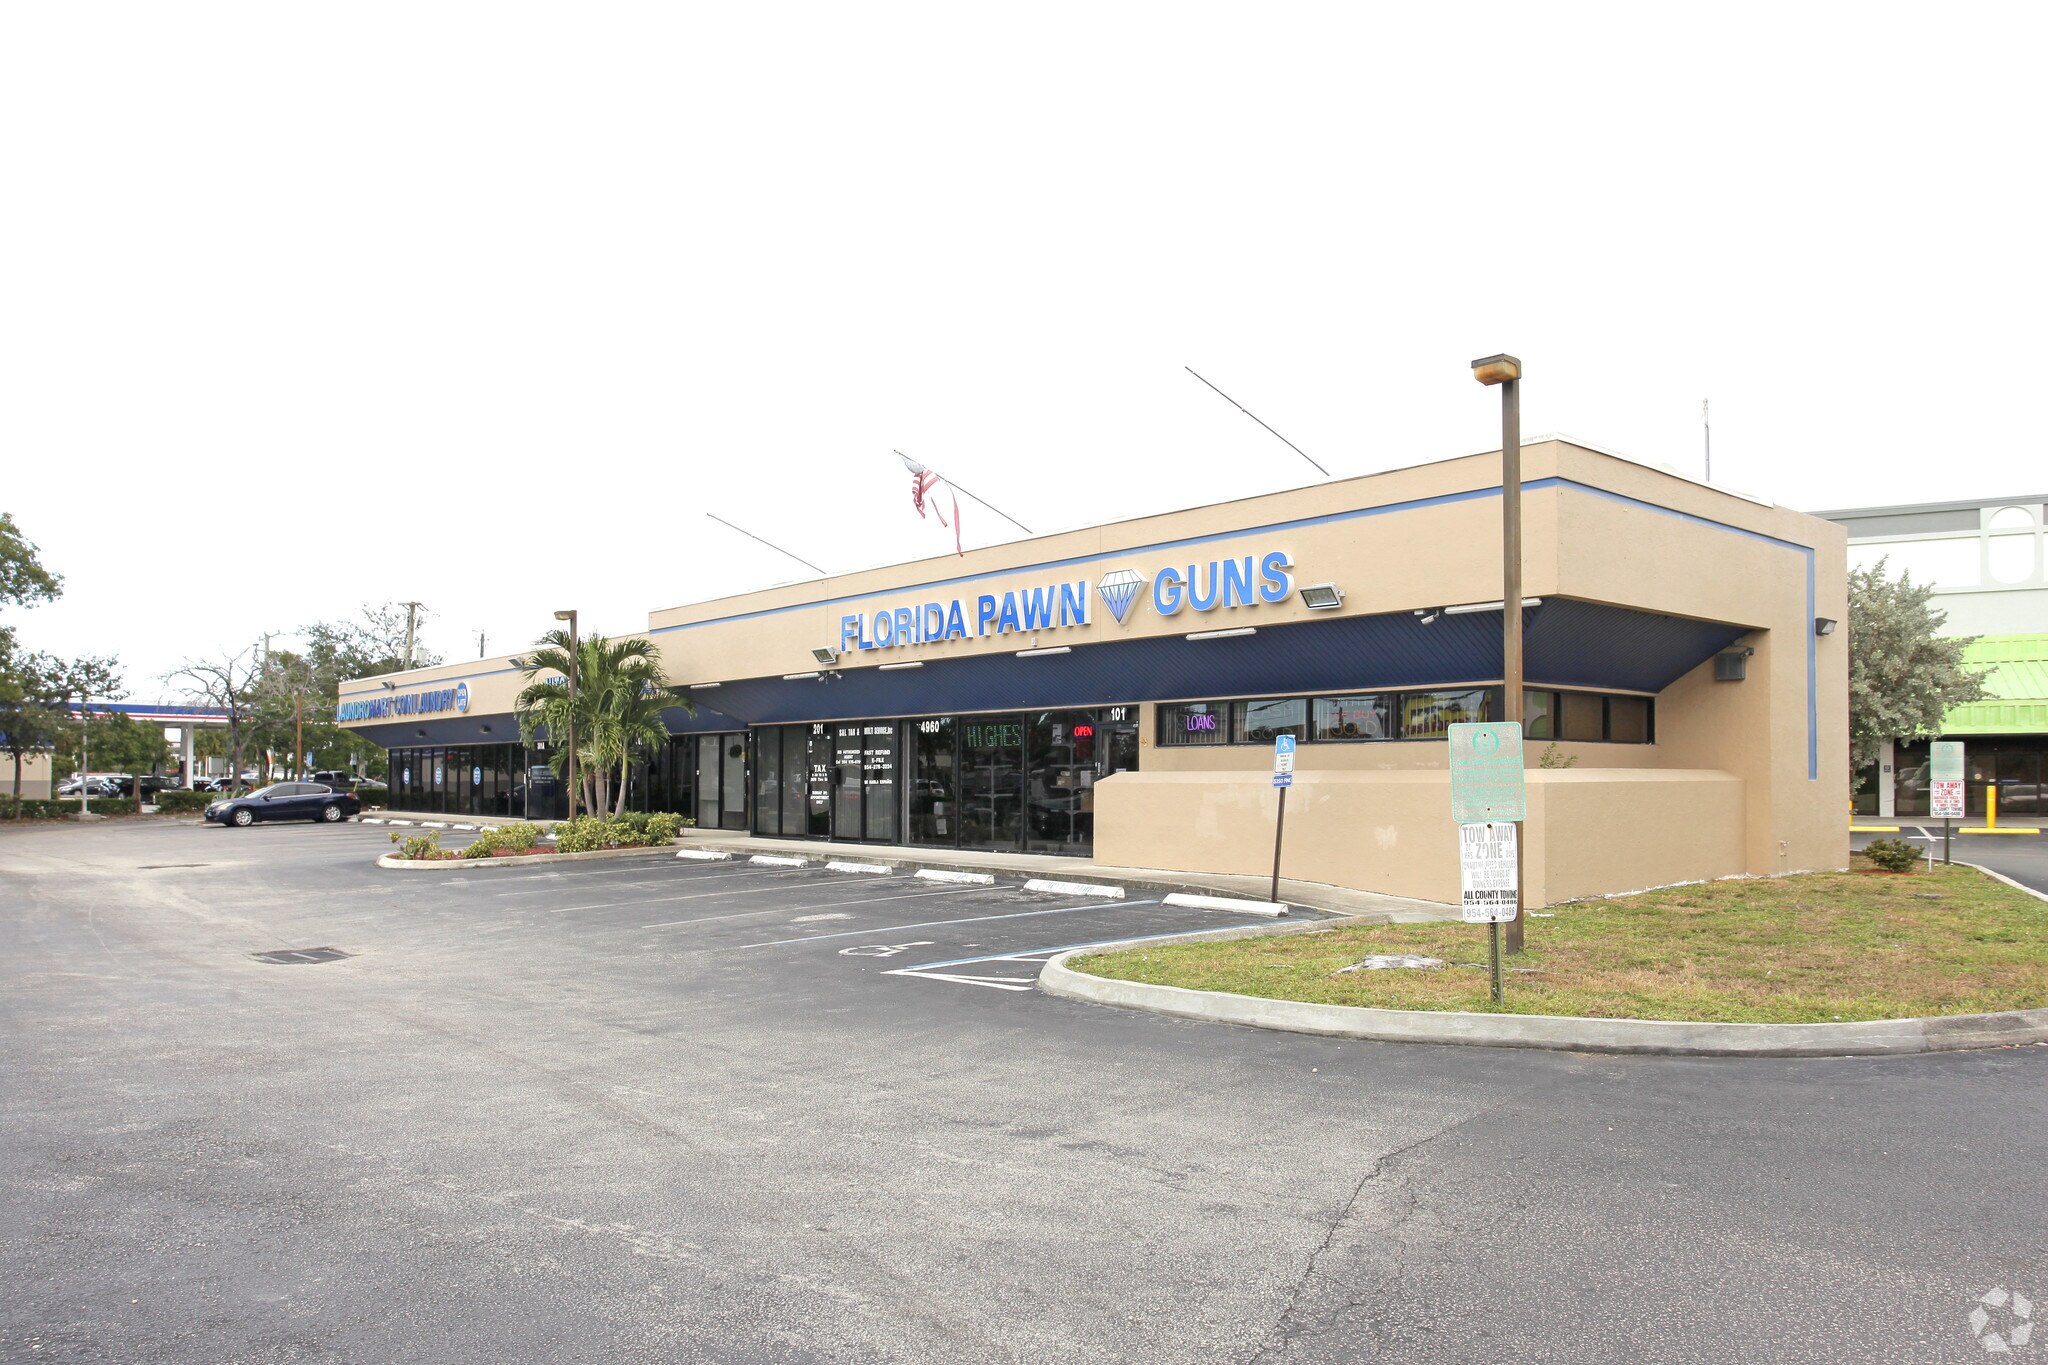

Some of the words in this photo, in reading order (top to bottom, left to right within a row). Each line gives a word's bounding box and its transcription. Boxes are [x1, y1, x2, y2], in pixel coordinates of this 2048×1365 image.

[1152, 551, 1294, 616] GUNS
[840, 600, 970, 653] FLORIDA
[977, 581, 1091, 637] PAWN
[336, 697, 392, 721] LAUNDROMART
[394, 693, 414, 714] COIN
[415, 688, 455, 713] LAUNDRY
[1110, 707, 1126, 721] 101
[1186, 714, 1216, 731] LOANS
[813, 724, 824, 734] 201
[920, 720, 940, 733] 4960
[1073, 725, 1094, 737] OPEN
[1462, 826, 1485, 843] TOW
[1489, 825, 1513, 842] AWAY
[1475, 842, 1503, 859] ZONE
[1463, 890, 1474, 900] ALL
[1475, 890, 1499, 900] COUNTY
